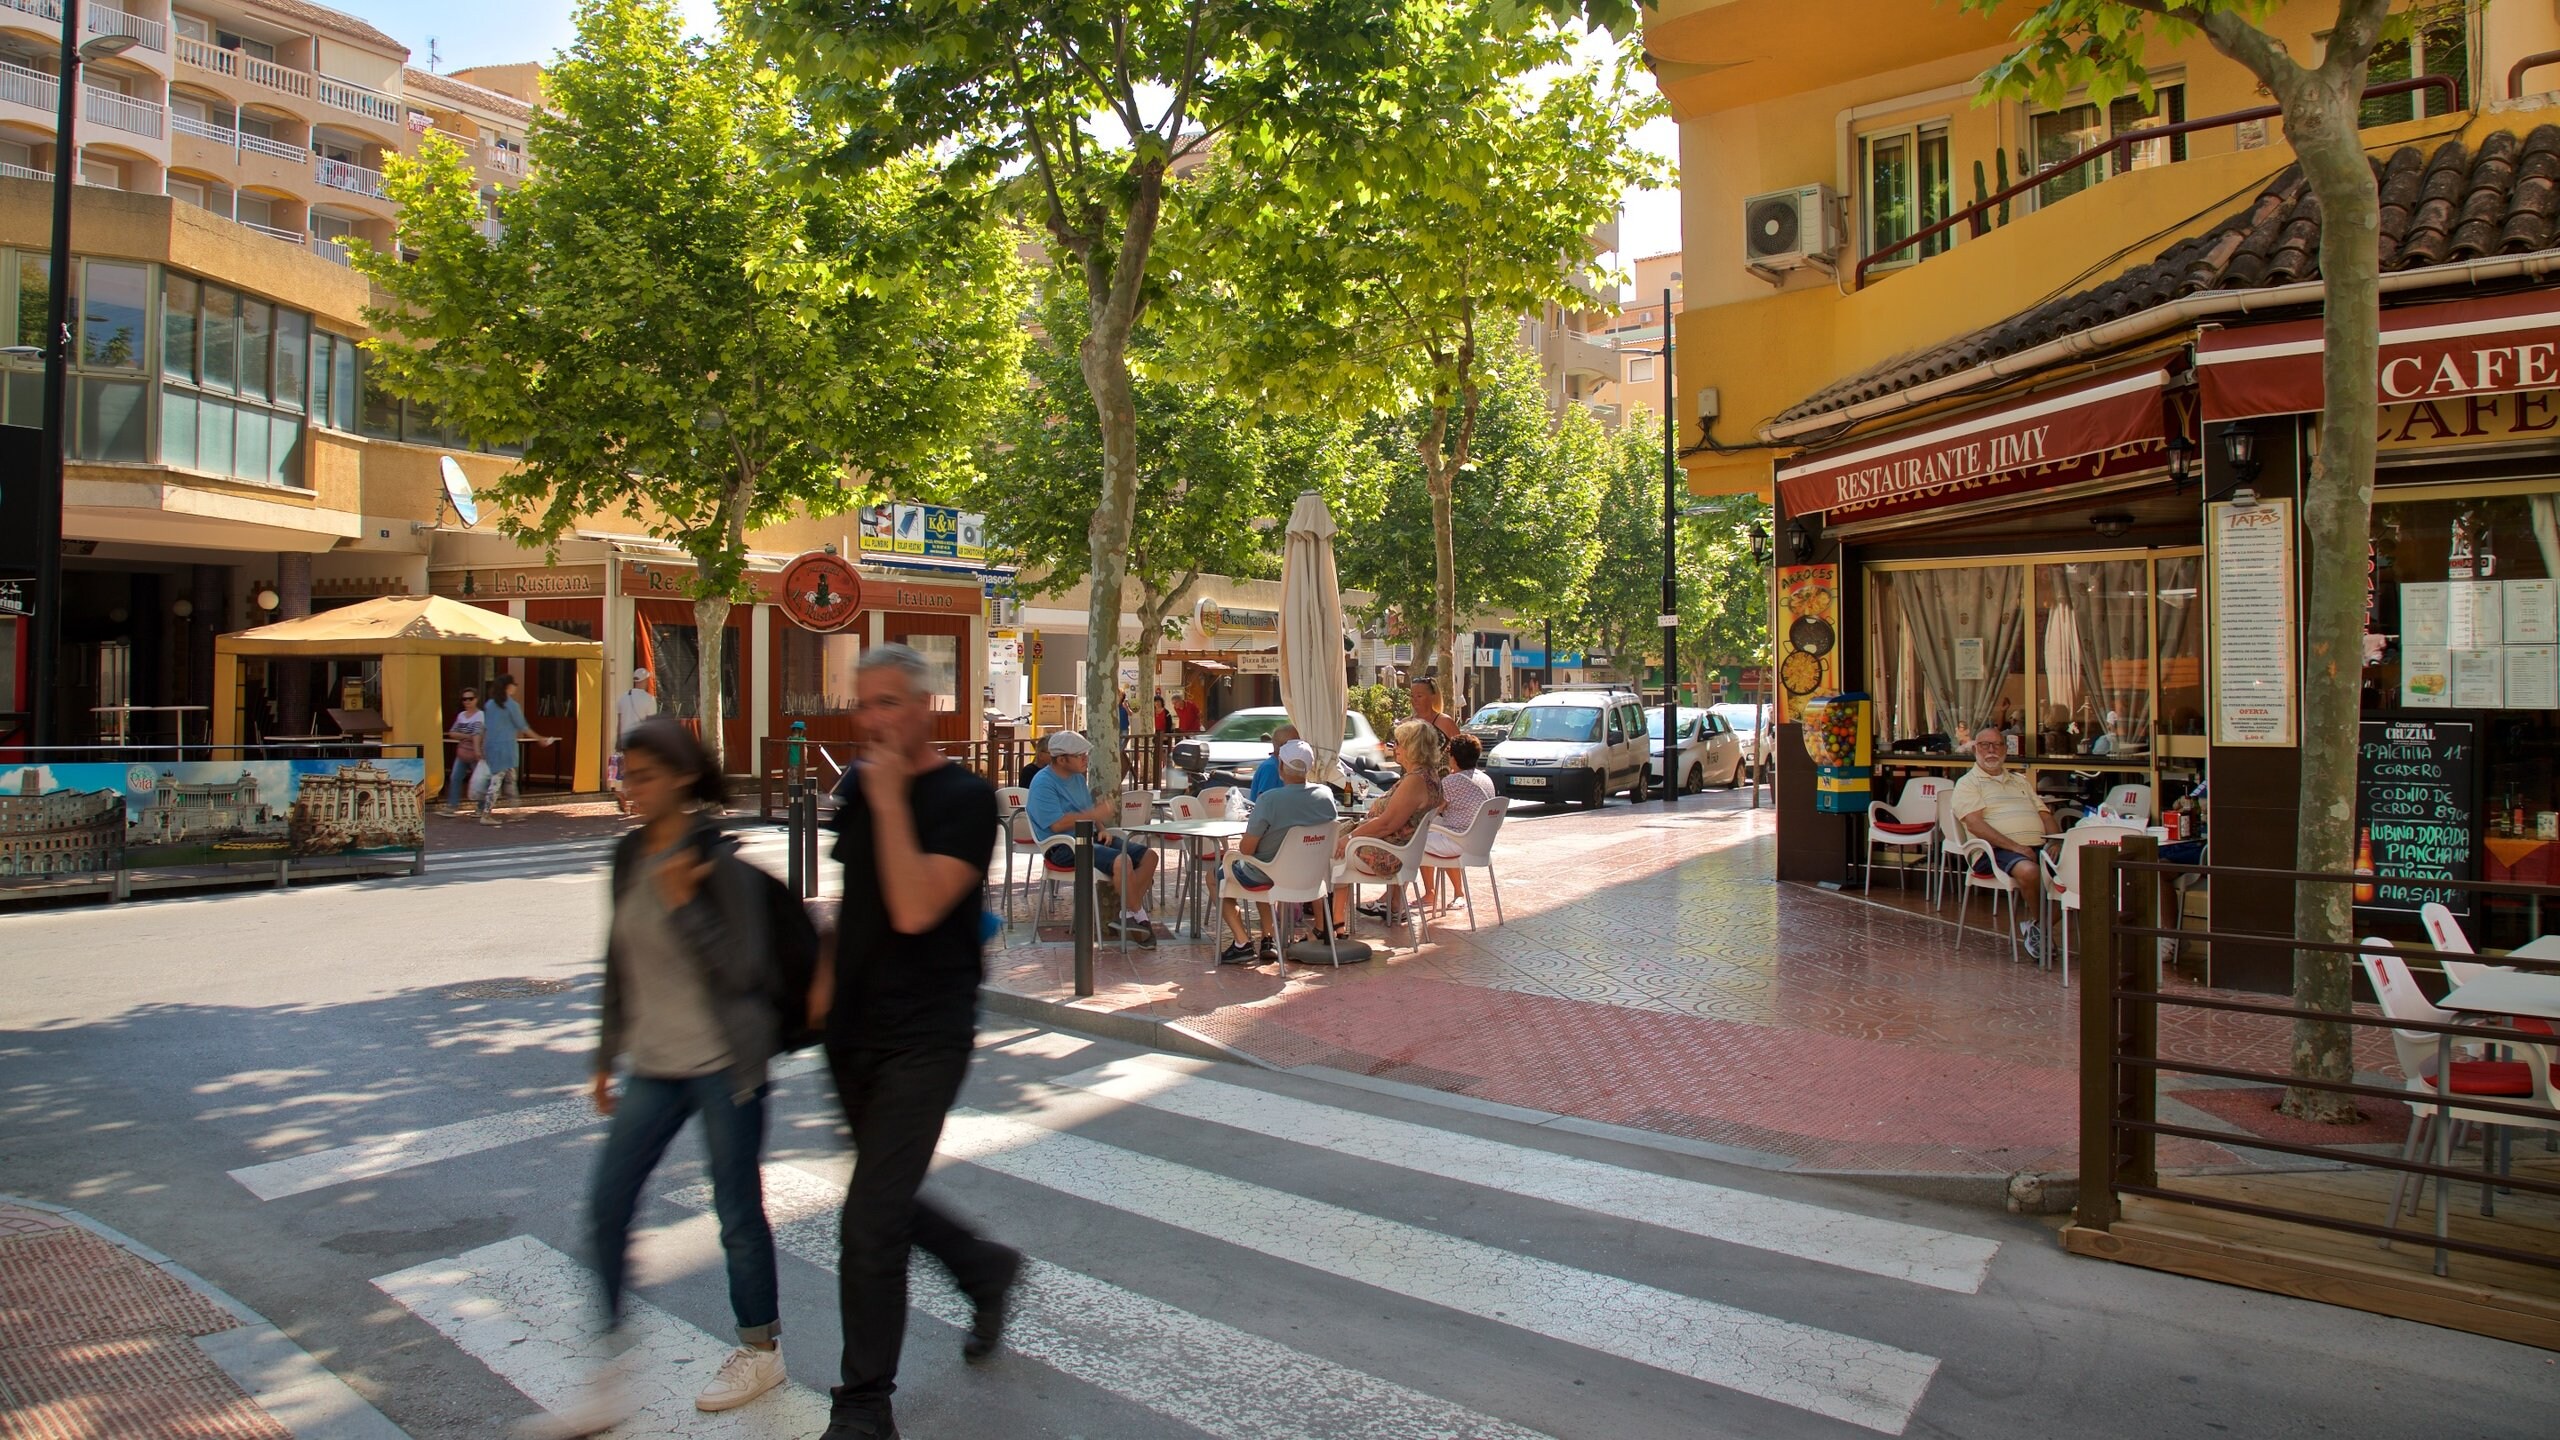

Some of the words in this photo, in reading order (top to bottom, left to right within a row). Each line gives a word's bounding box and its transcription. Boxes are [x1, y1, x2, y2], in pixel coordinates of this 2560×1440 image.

[2381, 342, 2558, 398] CAFE
[1836, 441, 1981, 503] RESTAURANTE
[1986, 424, 2050, 473] JIMY
[928, 514, 956, 533] K&M
[2224, 510, 2281, 529] TAPAS
[494, 571, 509, 593] La
[516, 572, 591, 594] Rusticana
[1781, 568, 1834, 590] ARROCES
[897, 588, 953, 608] Italiano
[2385, 728, 2437, 741] CRUZIAL
[2373, 763, 2442, 778] CORDERO
[2432, 789, 2454, 805] DE
[2371, 802, 2425, 816] CERDO
[1302, 834, 1326, 843] Mahou
